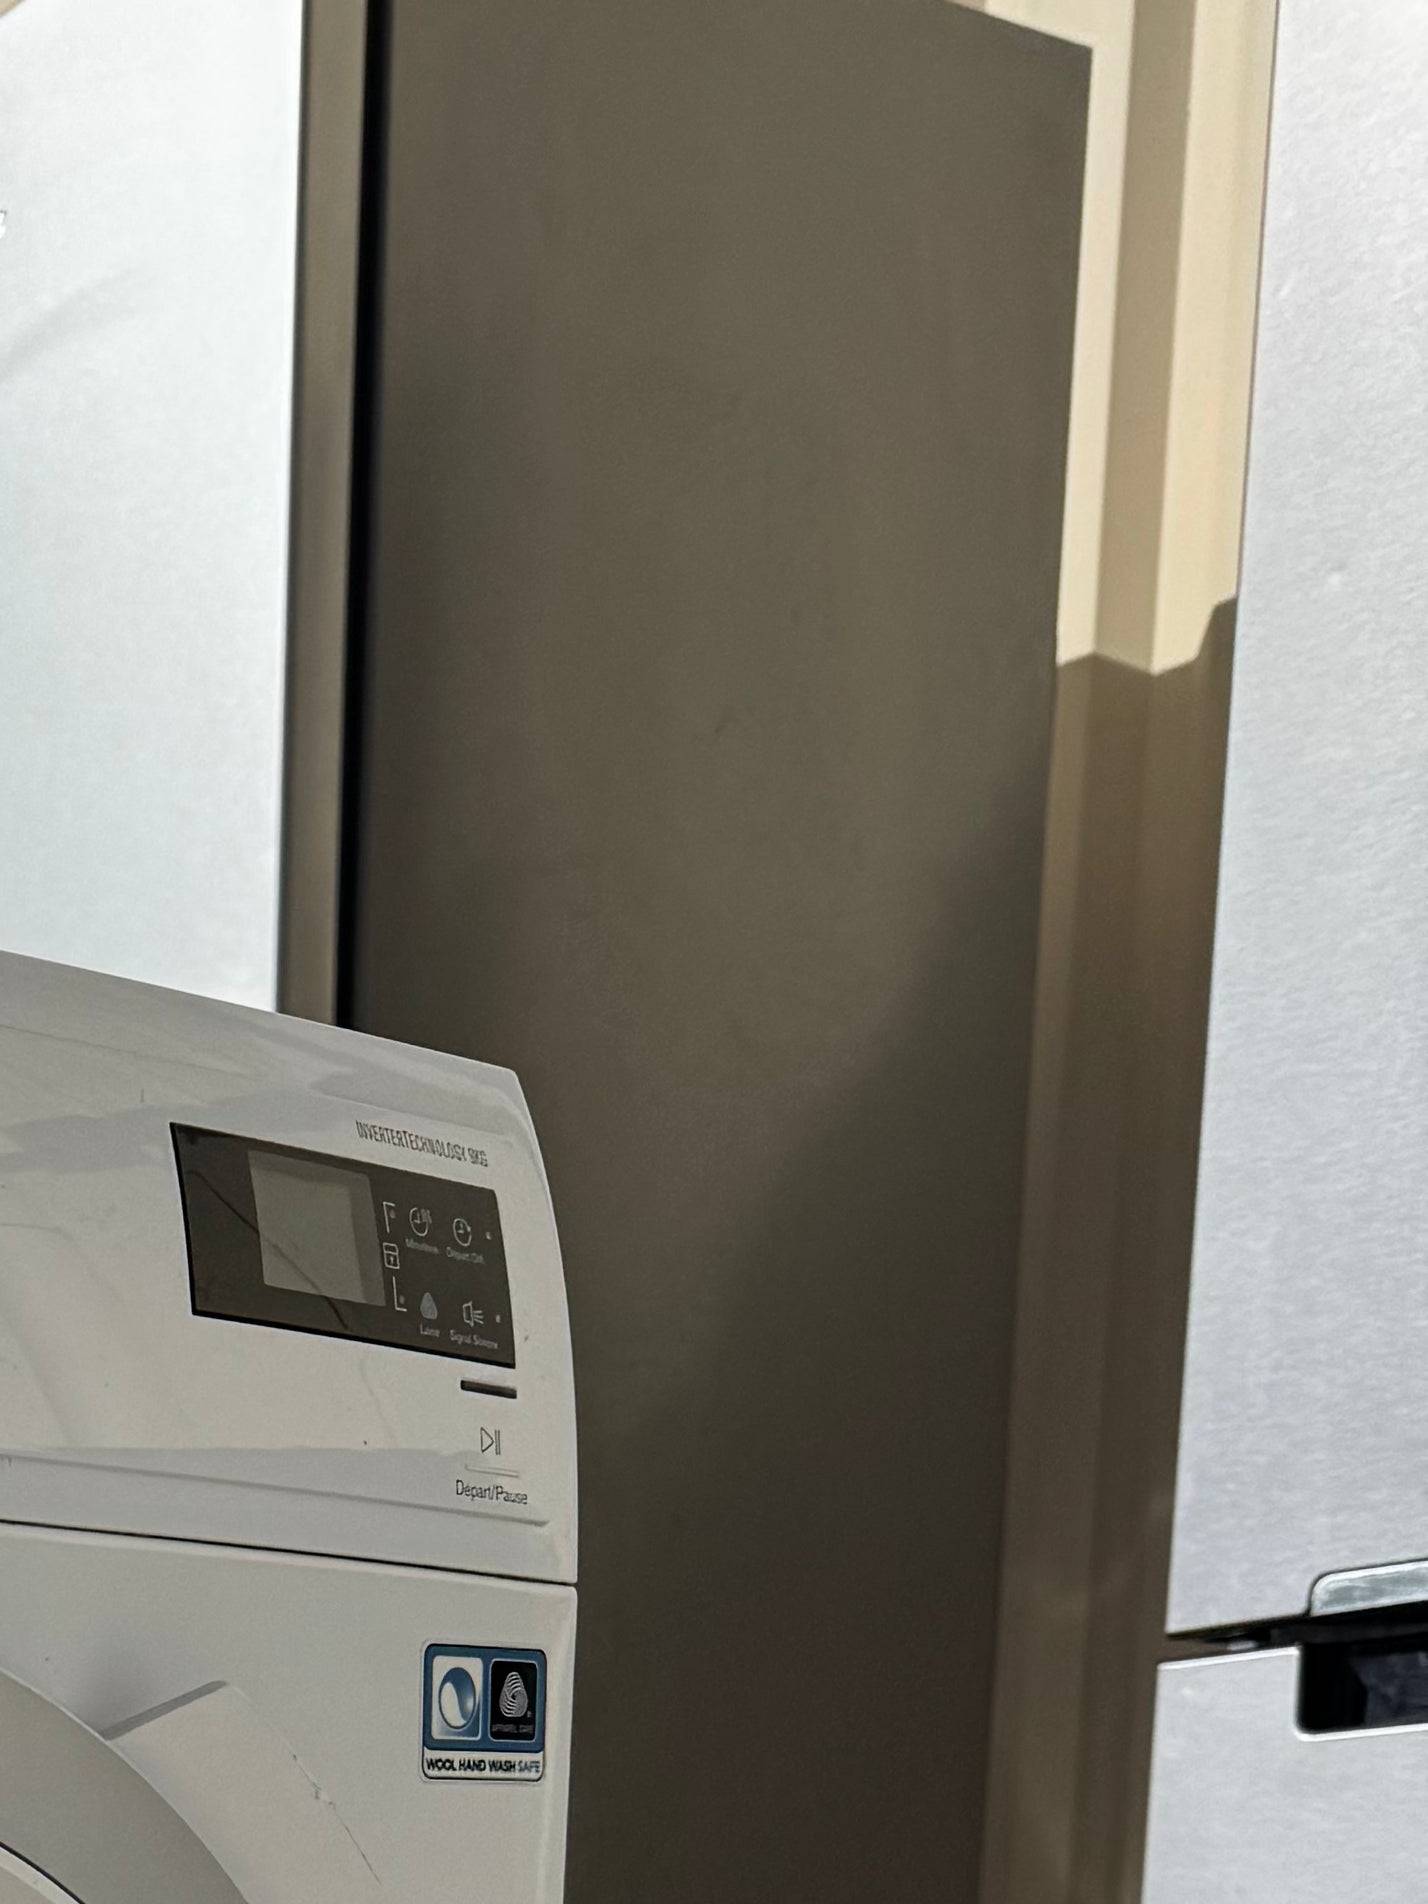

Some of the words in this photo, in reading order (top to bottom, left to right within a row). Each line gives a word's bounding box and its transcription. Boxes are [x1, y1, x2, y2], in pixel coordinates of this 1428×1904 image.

[426, 1758, 456, 1771] WOOL
[459, 1759, 485, 1771] HAND
[489, 1760, 515, 1773] WASH
[518, 1760, 540, 1773] SAFE
